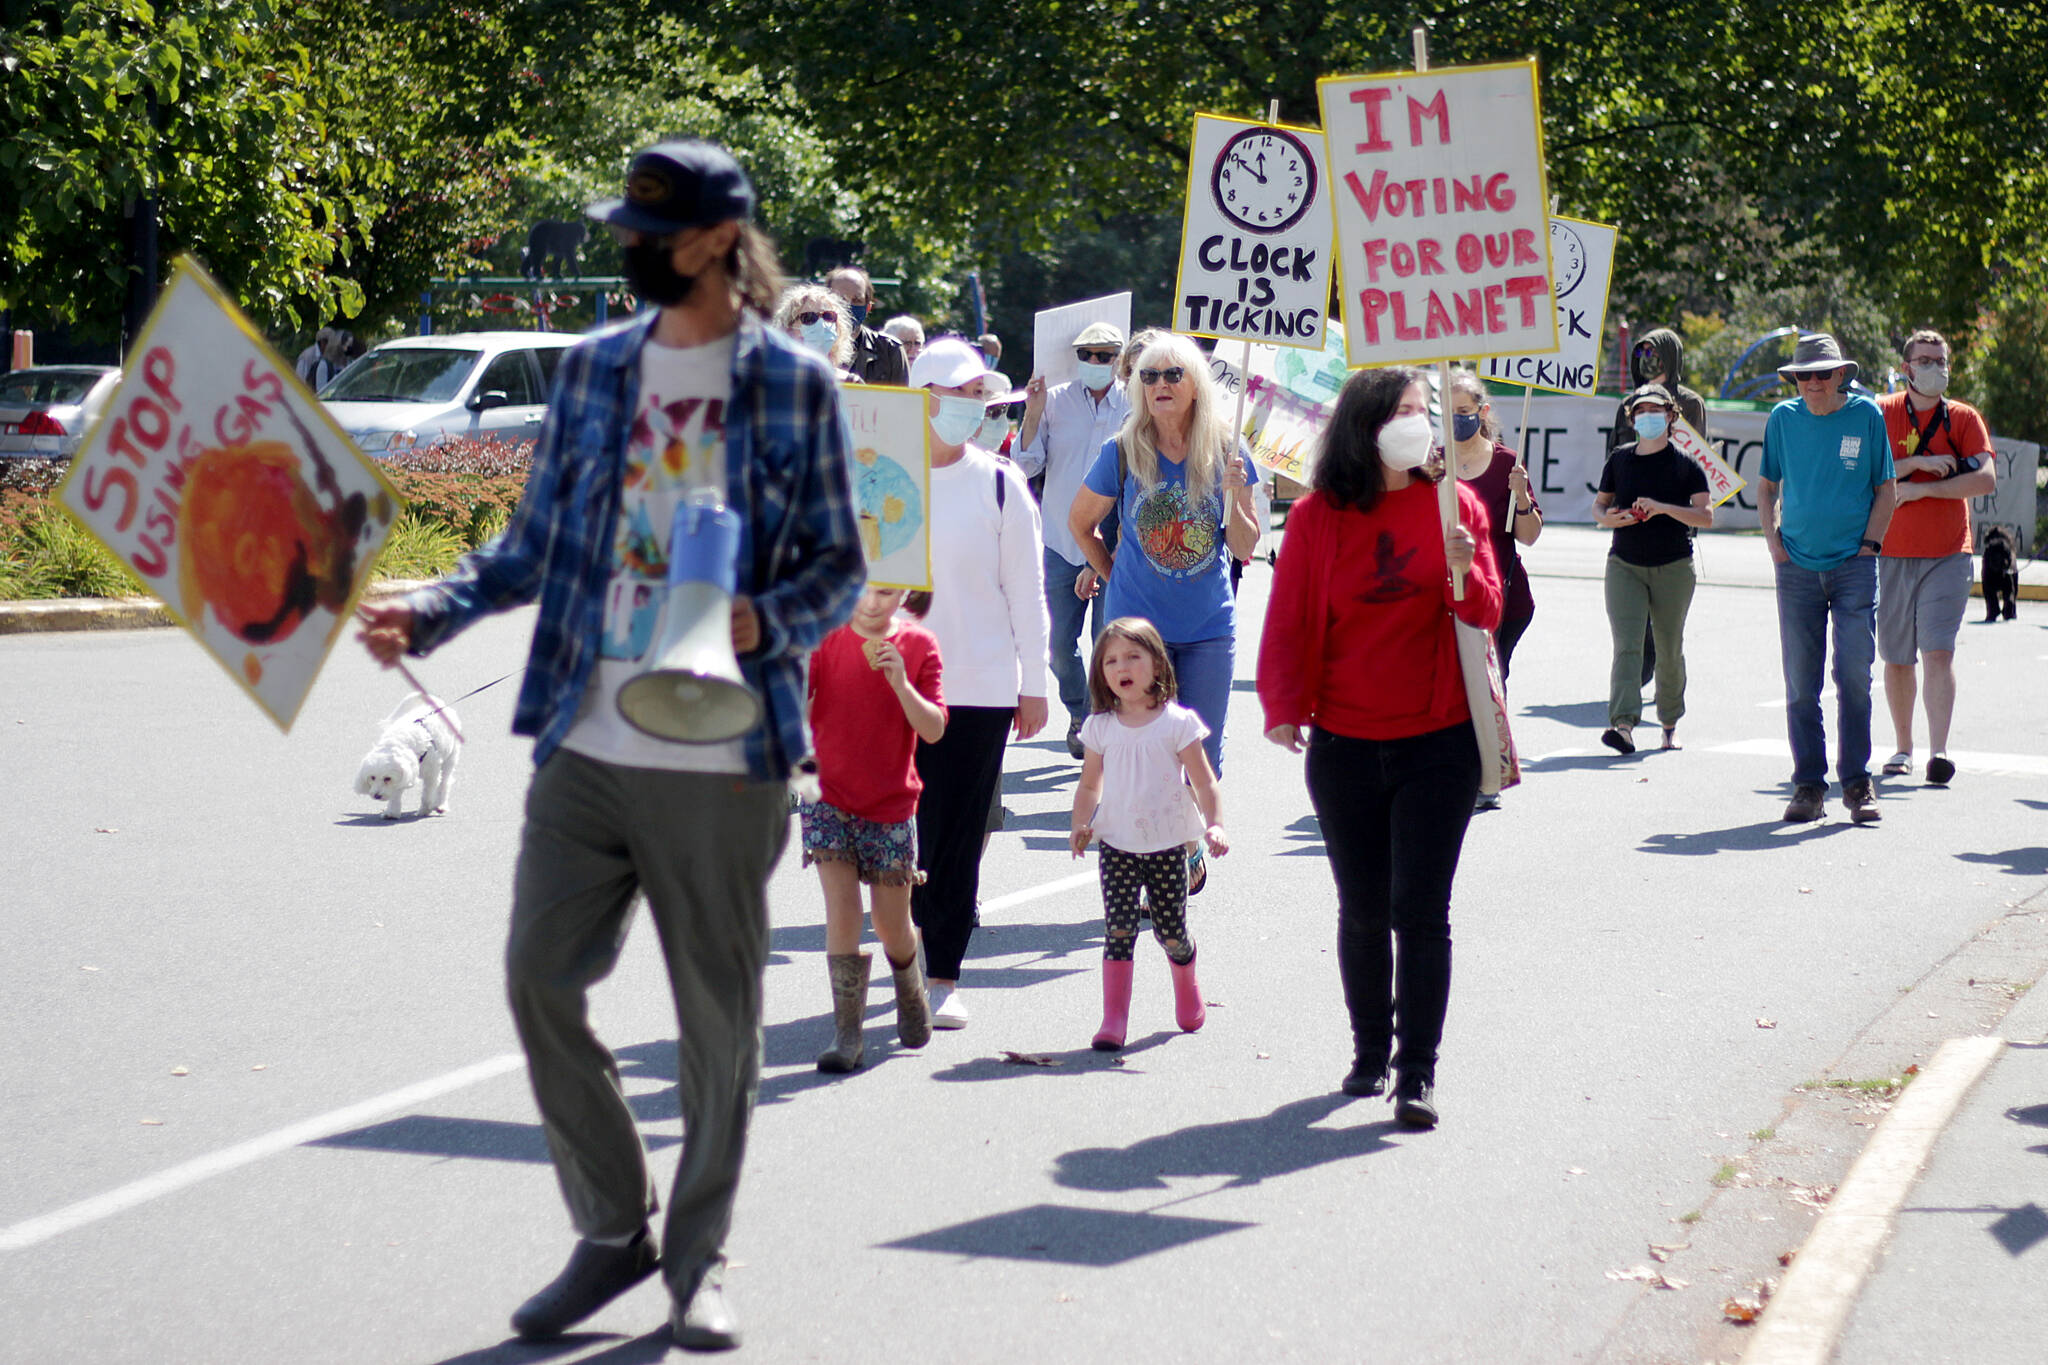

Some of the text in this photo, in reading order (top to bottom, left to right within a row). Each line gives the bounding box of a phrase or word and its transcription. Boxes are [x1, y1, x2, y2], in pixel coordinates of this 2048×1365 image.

[1349, 85, 1451, 155] I'M
[1242, 140, 1254, 150] 11
[1261, 136, 1273, 147] 12
[1226, 153, 1239, 163] 10
[1288, 160, 1298, 171] 2
[1222, 169, 1231, 183] 9
[1294, 176, 1304, 186] 3
[1227, 189, 1236, 201] 8
[1287, 192, 1298, 203] 4
[1343, 169, 1517, 223] VOTING
[1241, 206, 1250, 217] 7
[1257, 211, 1268, 222] 6
[1273, 207, 1283, 218] 5
[1568, 244, 1576, 253] 2
[1199, 235, 1316, 282] CLOCK
[1363, 228, 1540, 283] FOR OUR
[1570, 258, 1579, 269] 3
[1238, 277, 1276, 307] IS
[1555, 282, 1563, 292] 5
[1185, 295, 1319, 337] TICKING
[1359, 275, 1550, 346] PLANET
[83, 346, 182, 533] STOP
[131, 359, 283, 578] USING GAS
